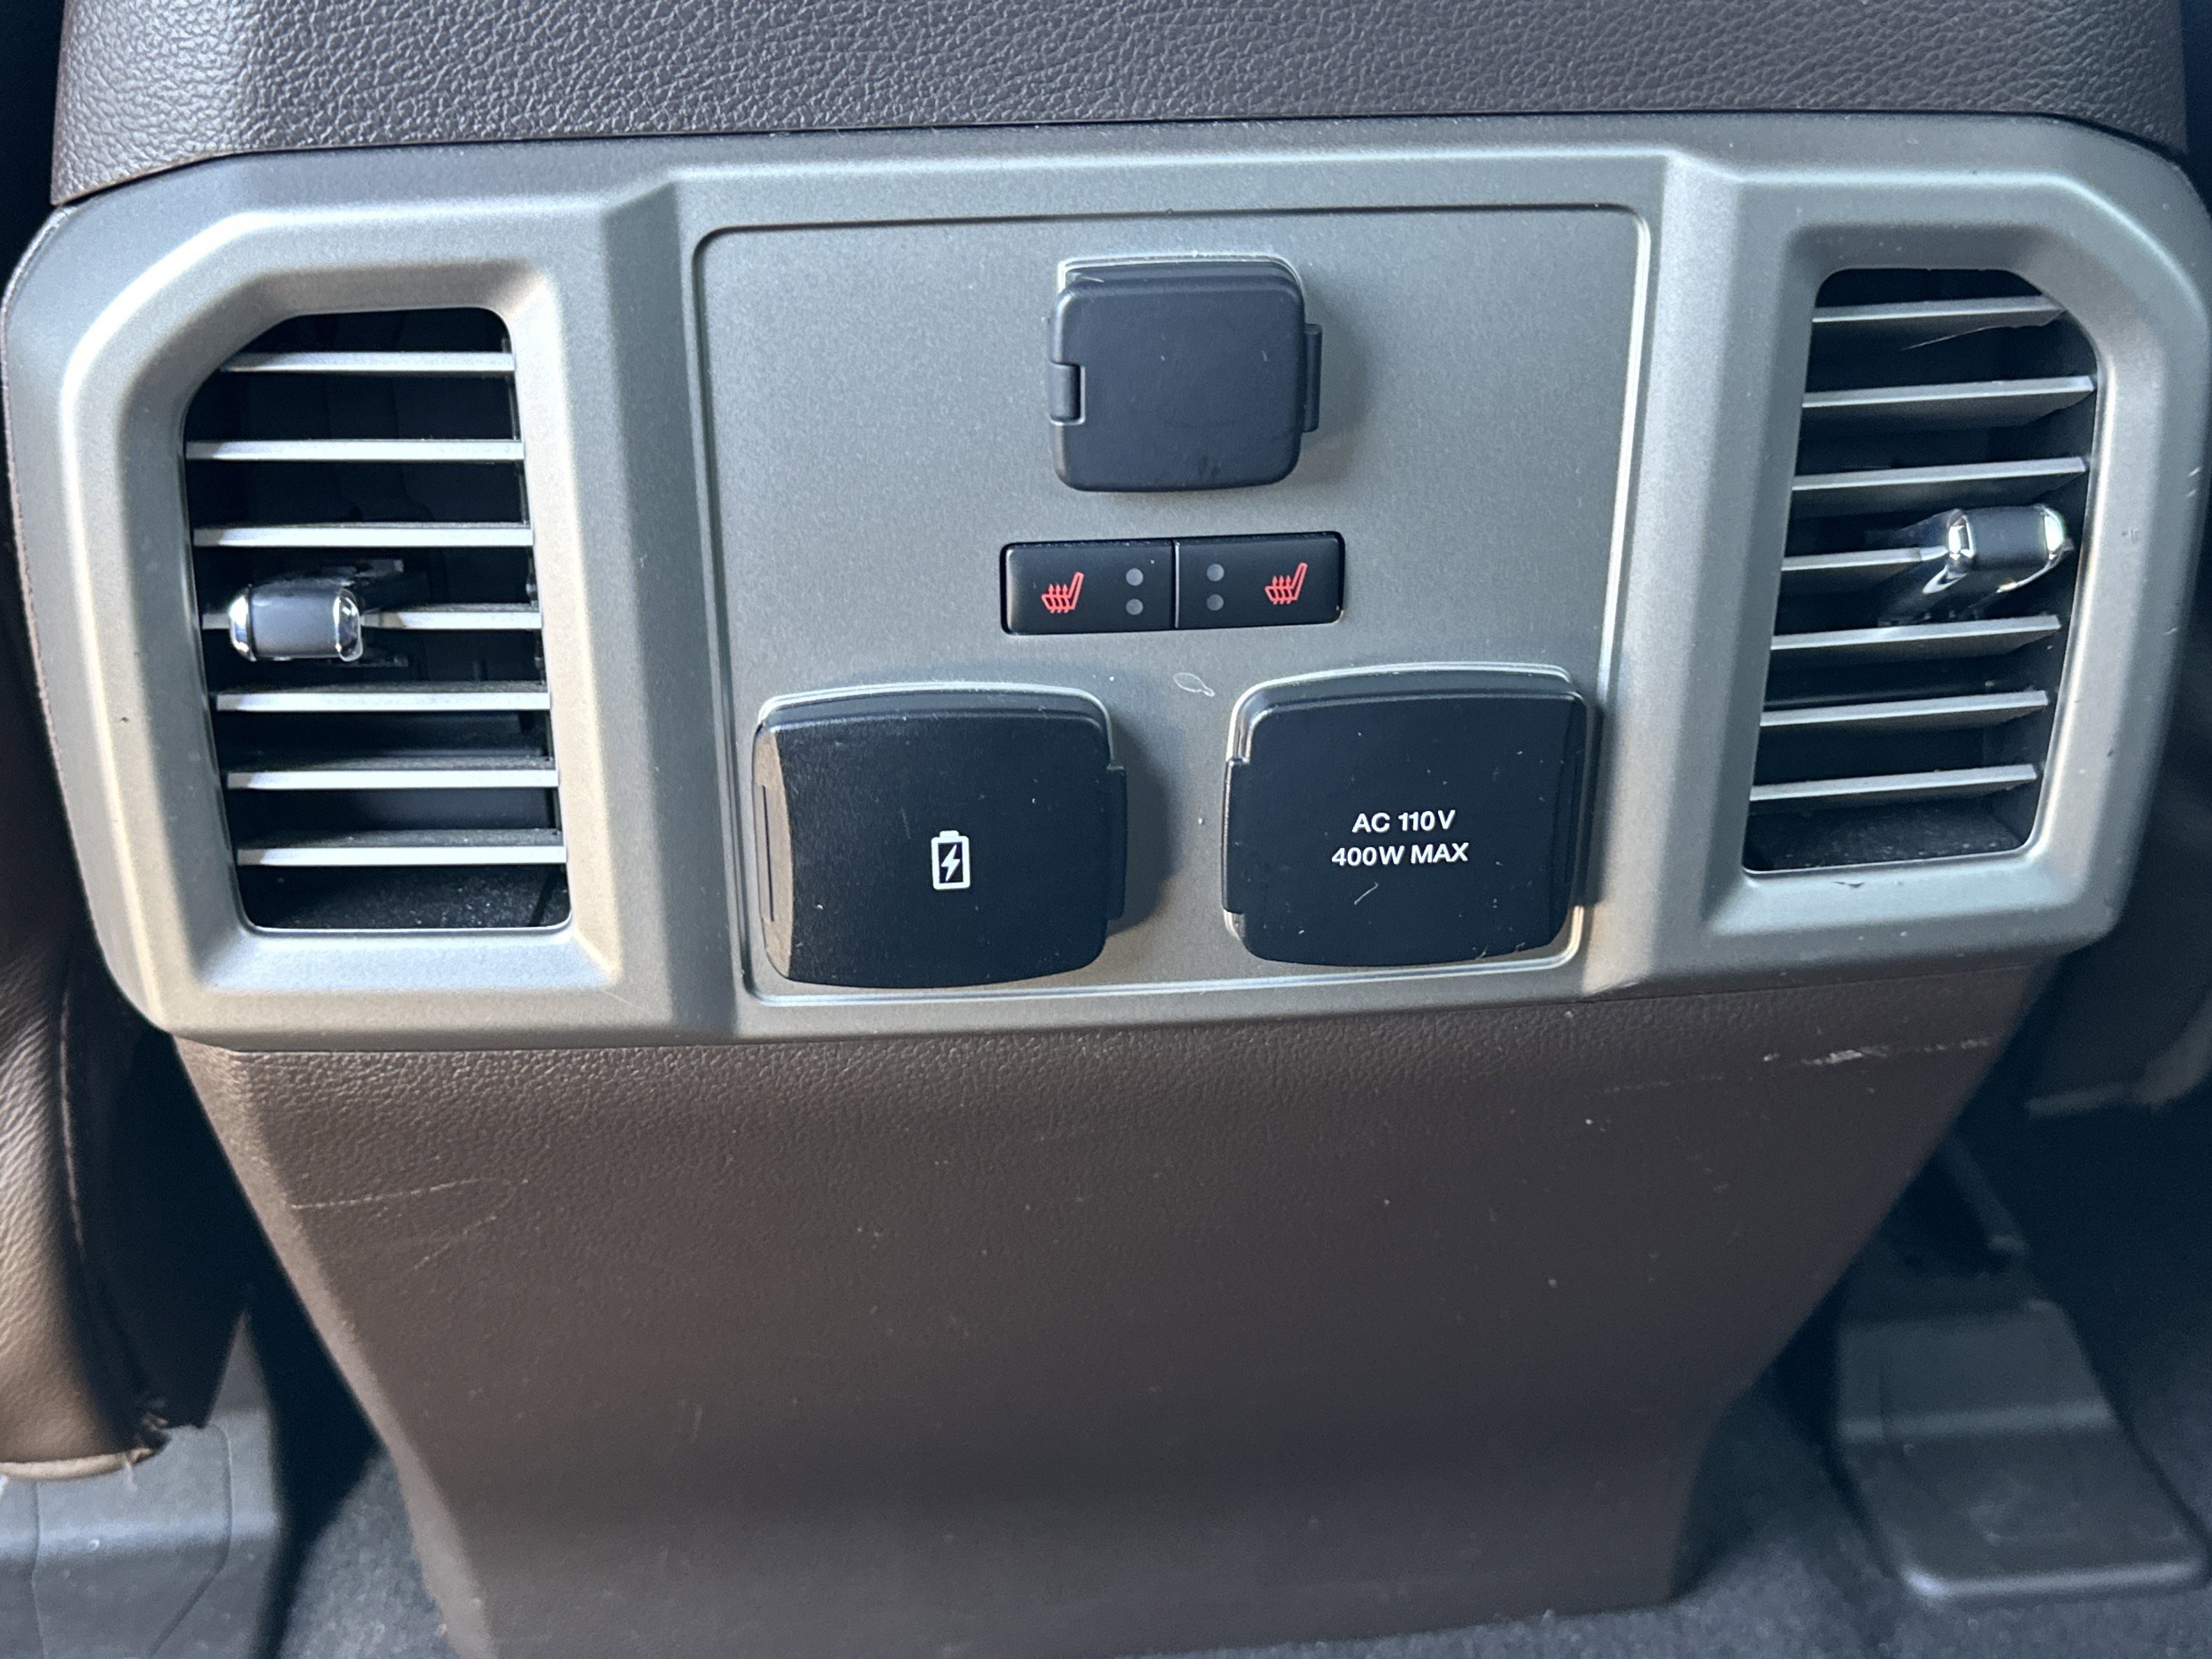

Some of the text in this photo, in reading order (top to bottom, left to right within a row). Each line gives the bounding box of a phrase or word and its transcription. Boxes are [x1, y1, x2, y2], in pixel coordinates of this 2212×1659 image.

[1352, 810, 1455, 833] AC 110V
[1331, 843, 1469, 866] 400W MAX
